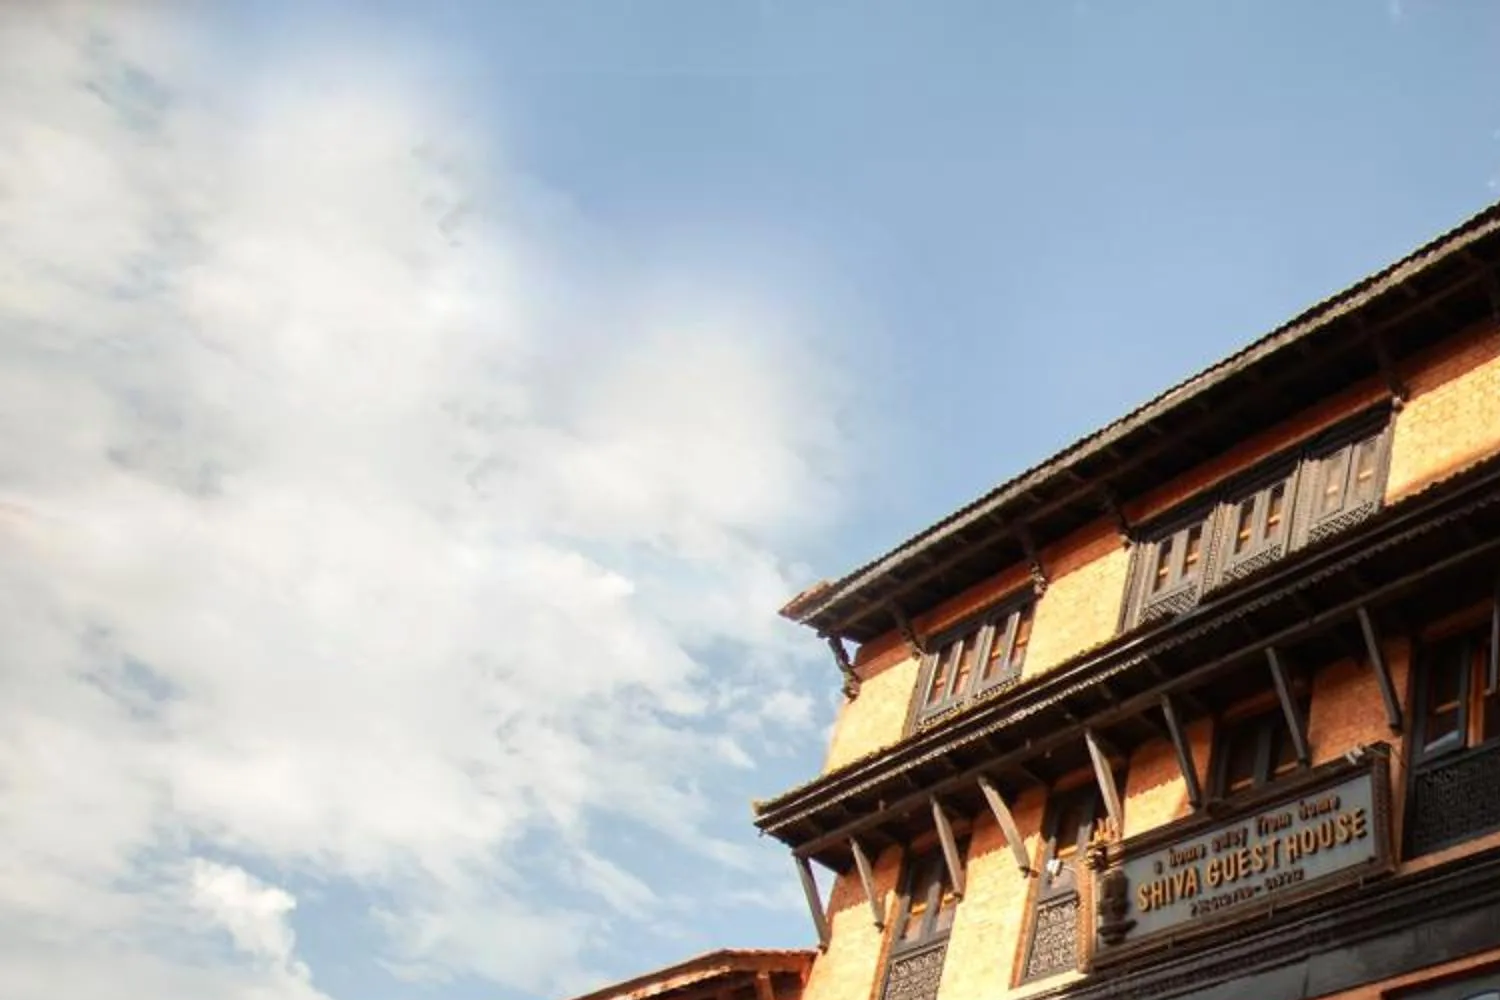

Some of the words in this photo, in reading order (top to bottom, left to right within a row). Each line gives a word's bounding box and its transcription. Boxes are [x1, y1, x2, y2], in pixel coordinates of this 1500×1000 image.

[1137, 865, 1200, 912] SHIVA
[1205, 834, 1281, 887] GUEST
[1285, 807, 1367, 863] HOUSE
